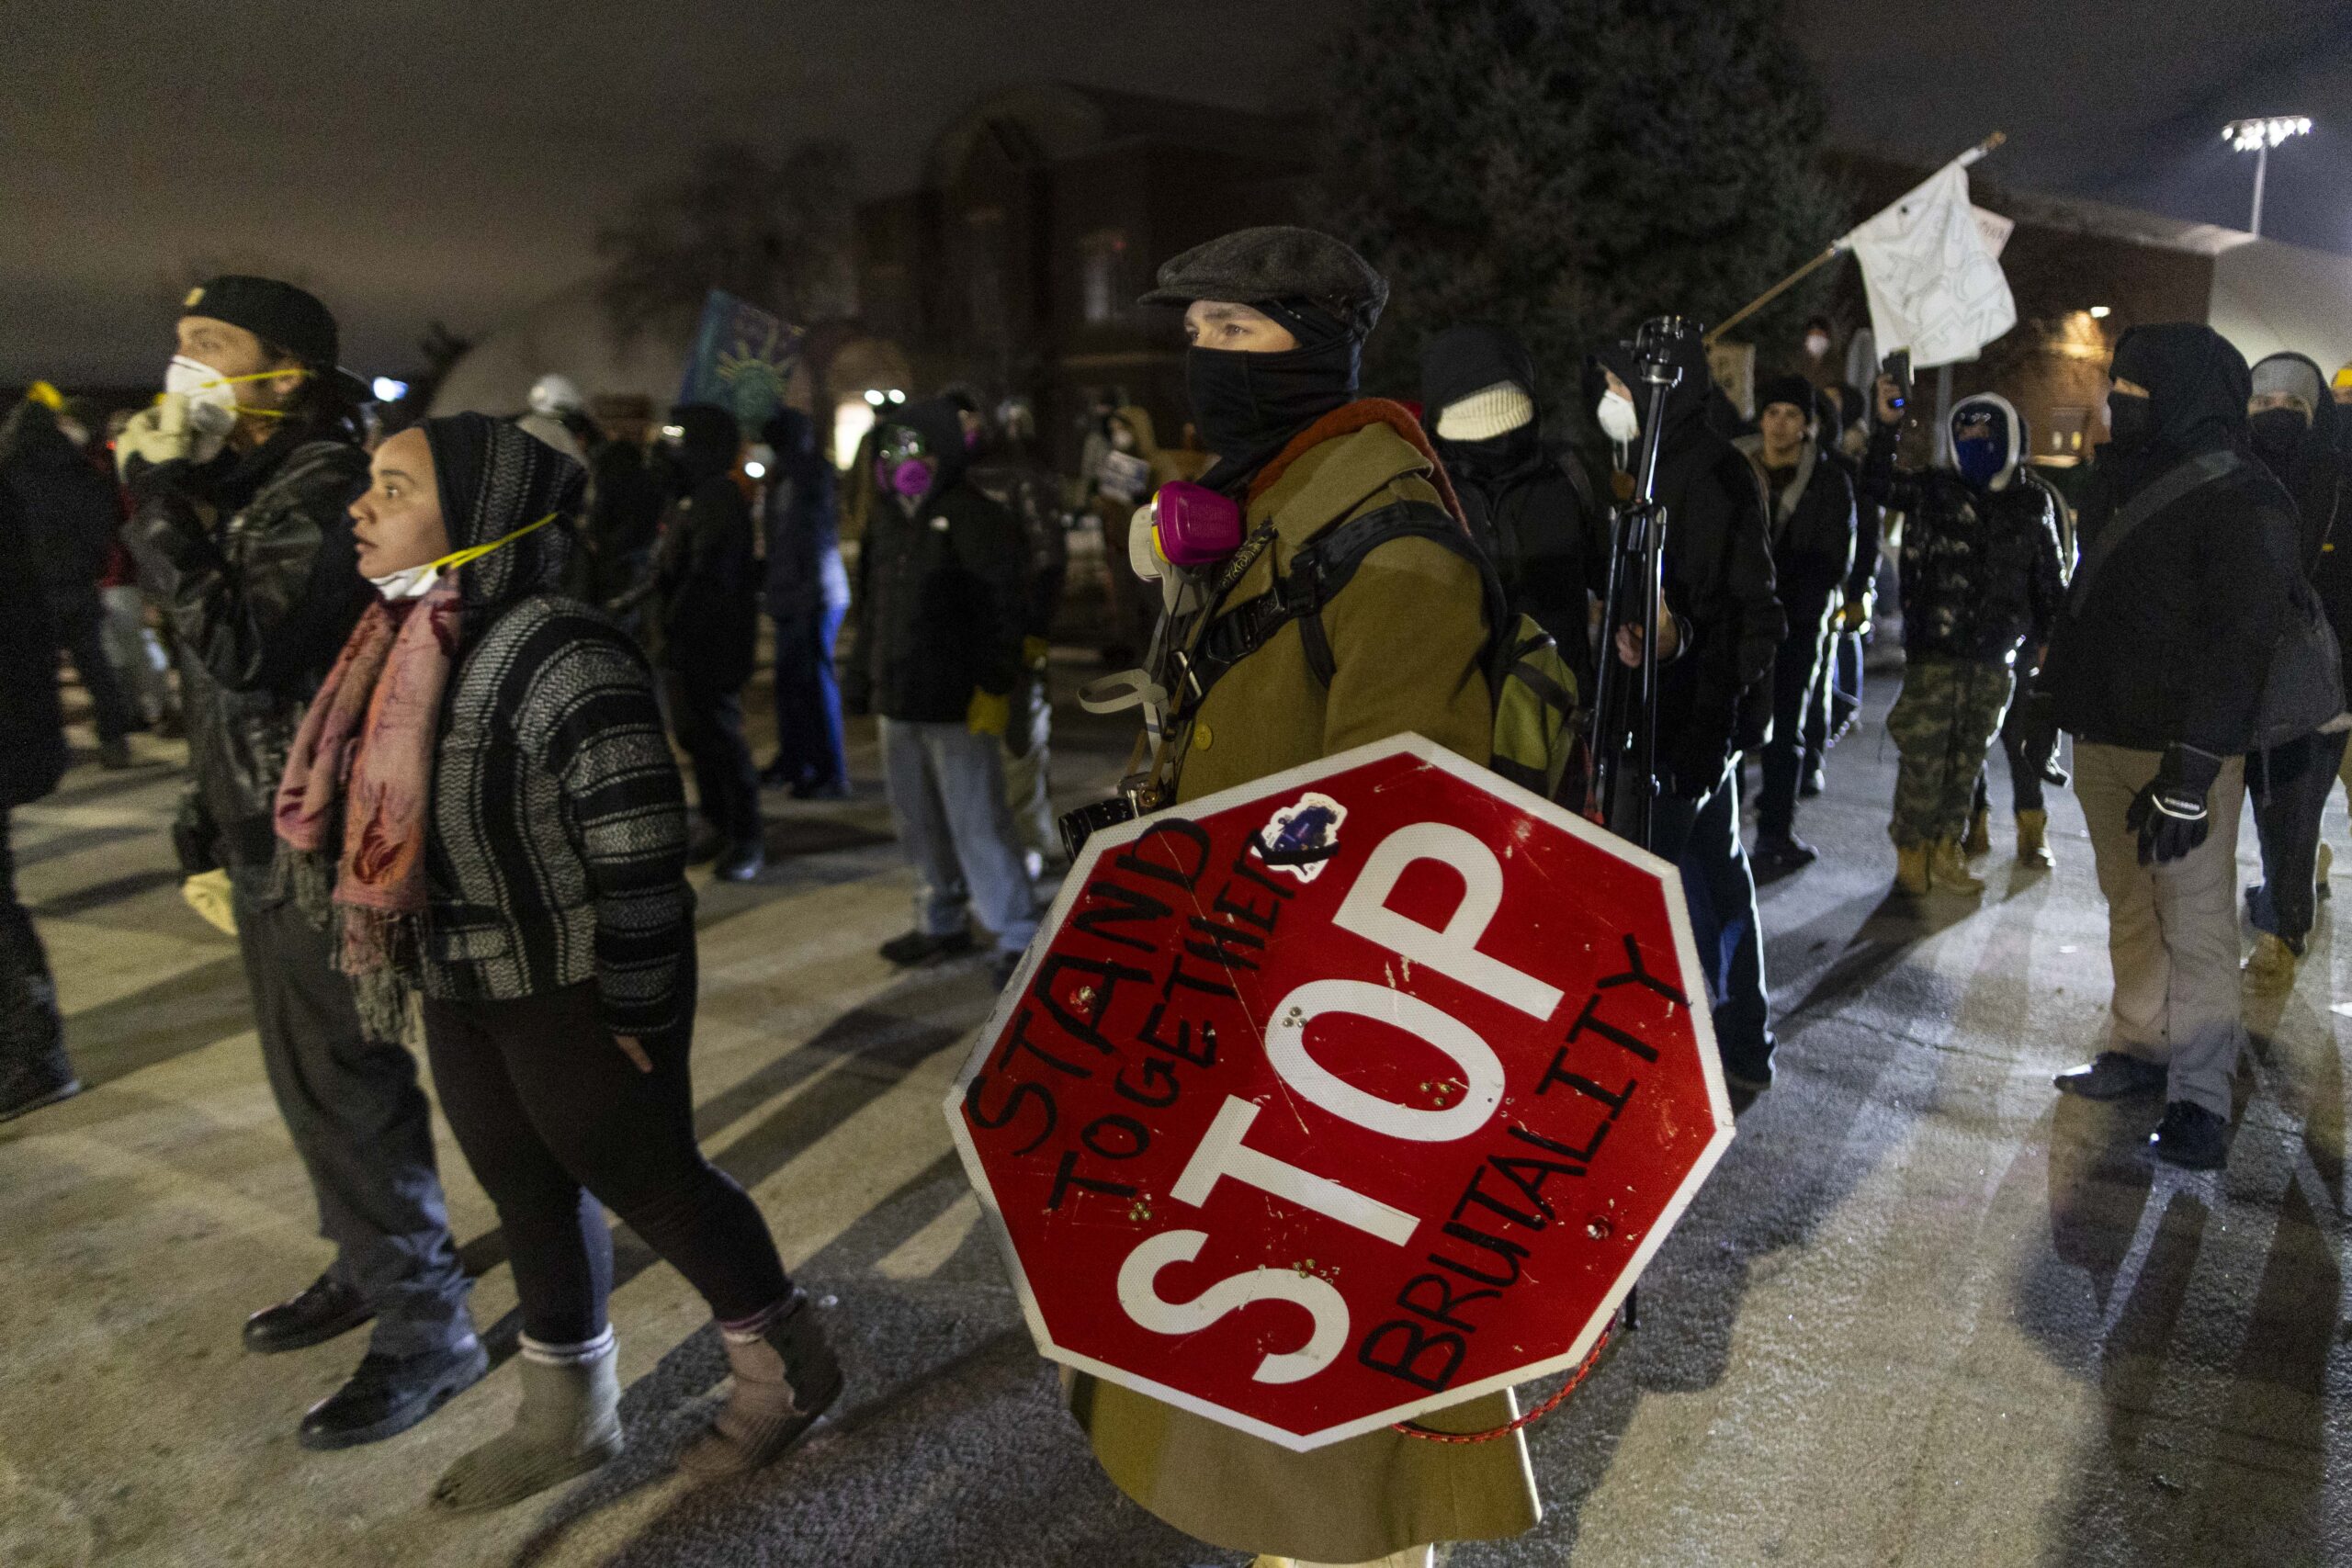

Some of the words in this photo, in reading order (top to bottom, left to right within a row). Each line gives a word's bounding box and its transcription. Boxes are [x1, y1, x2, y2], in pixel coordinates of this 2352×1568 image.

[967, 817, 1211, 1156] STAND
[1048, 829, 1340, 1211] TOGETHER
[1117, 822, 1565, 1384] STOP
[1358, 934, 1691, 1393] BRUTALITY
